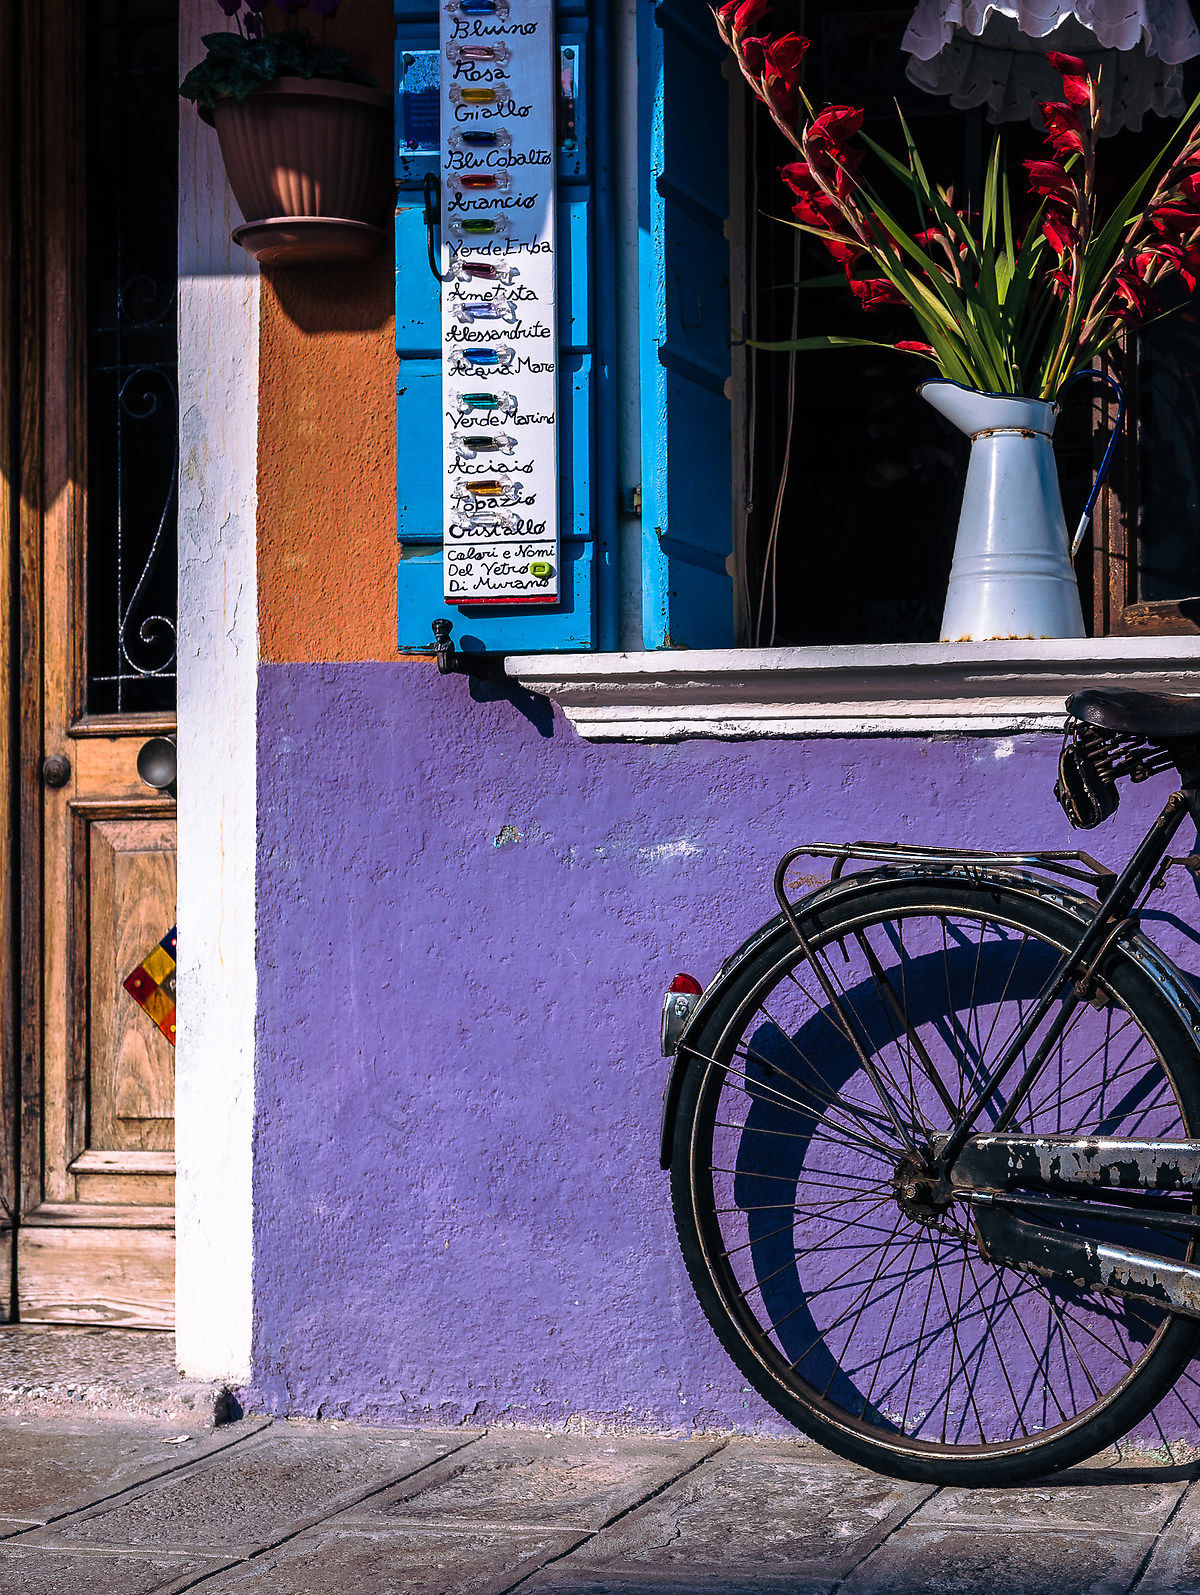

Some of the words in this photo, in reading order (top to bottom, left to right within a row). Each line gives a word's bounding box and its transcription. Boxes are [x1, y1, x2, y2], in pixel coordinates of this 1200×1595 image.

[450, 18, 539, 38] Bluino
[452, 60, 511, 82] Rosa
[454, 99, 532, 122] Giallo
[486, 150, 552, 168] Cobalto
[448, 191, 539, 212] Arancio
[445, 239, 501, 258] Verde
[501, 234, 554, 255] Erba
[448, 282, 539, 302] Ametista
[445, 320, 551, 342] Alessandrite
[448, 361, 515, 380] Acqua
[516, 356, 555, 374] Mare
[445, 411, 500, 429] Verde
[500, 410, 555, 427] Marino
[448, 456, 534, 475] Acciaio
[450, 492, 536, 513] Topazio
[448, 518, 547, 539] Cristallo
[503, 549, 512, 560] e
[515, 544, 555, 559] Nomi
[448, 563, 473, 577] Del
[481, 561, 530, 576] Vetro
[449, 579, 468, 592] Di
[473, 577, 551, 592] Murano
